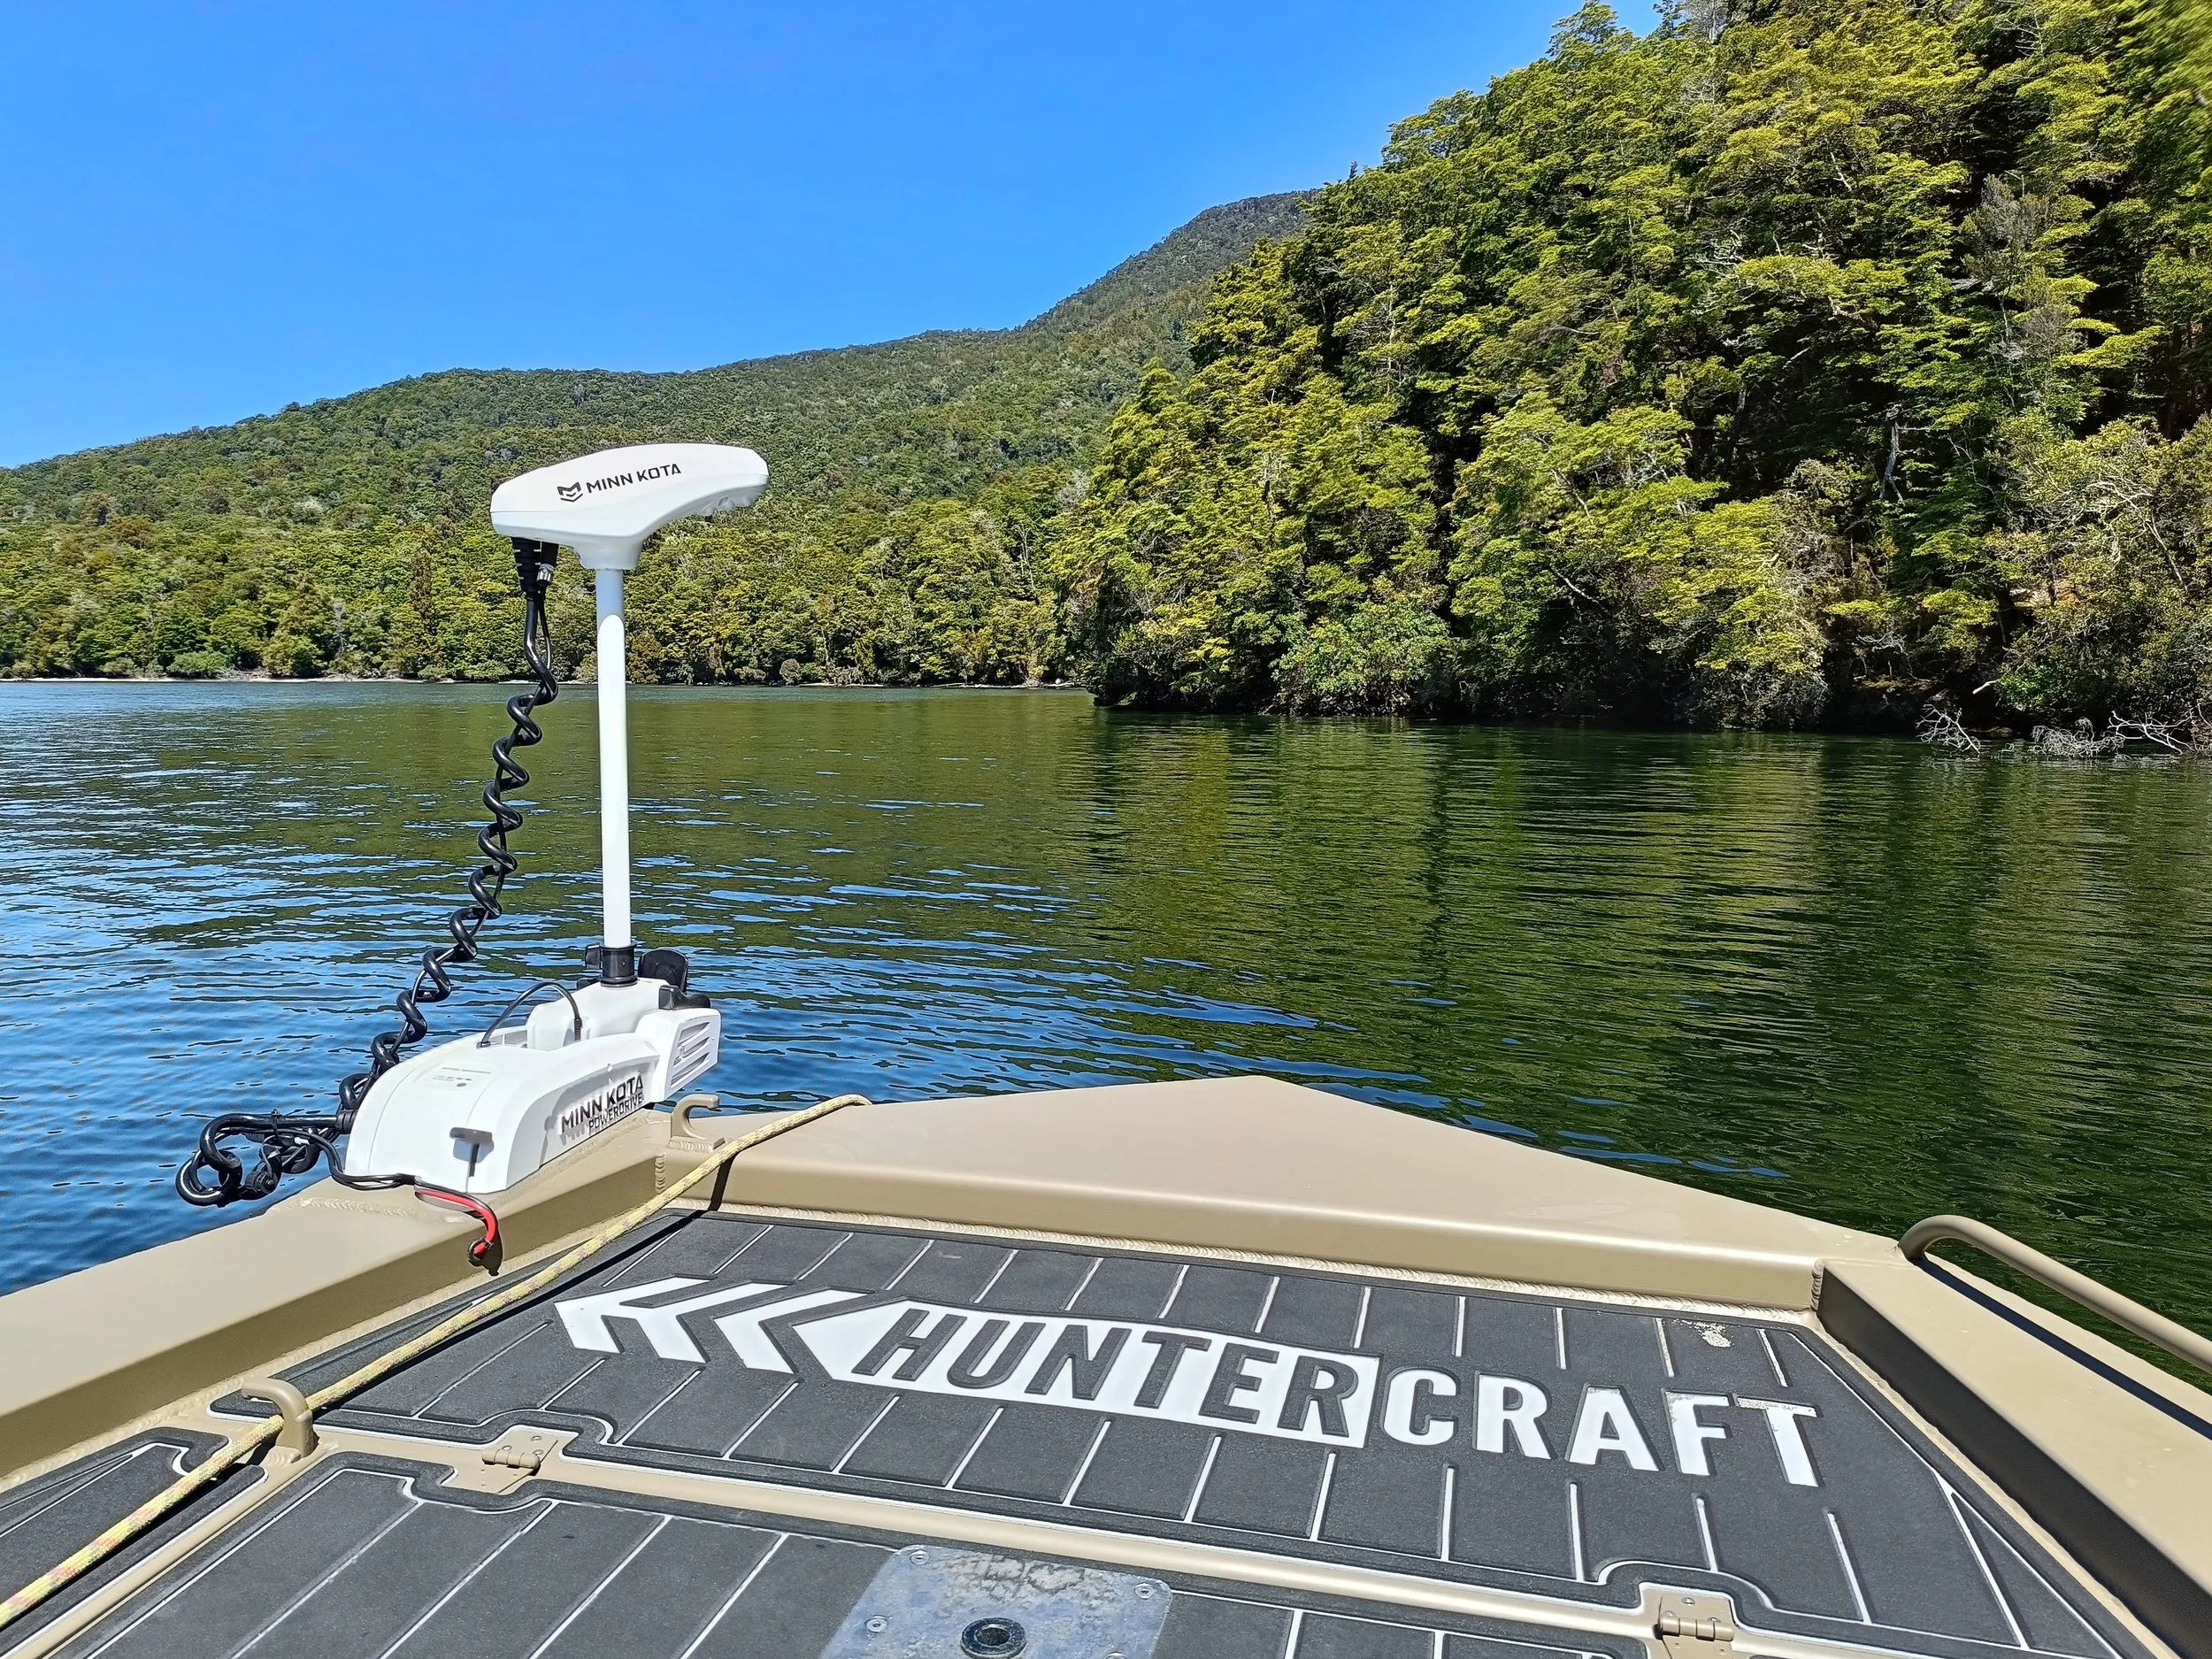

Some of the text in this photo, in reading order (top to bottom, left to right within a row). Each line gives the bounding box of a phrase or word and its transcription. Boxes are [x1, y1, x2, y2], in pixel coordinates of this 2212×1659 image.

[586, 464, 681, 494] MINN KOTA
[562, 1073, 643, 1132] MINN KOTA
[588, 1094, 643, 1133] POWERDRIVE
